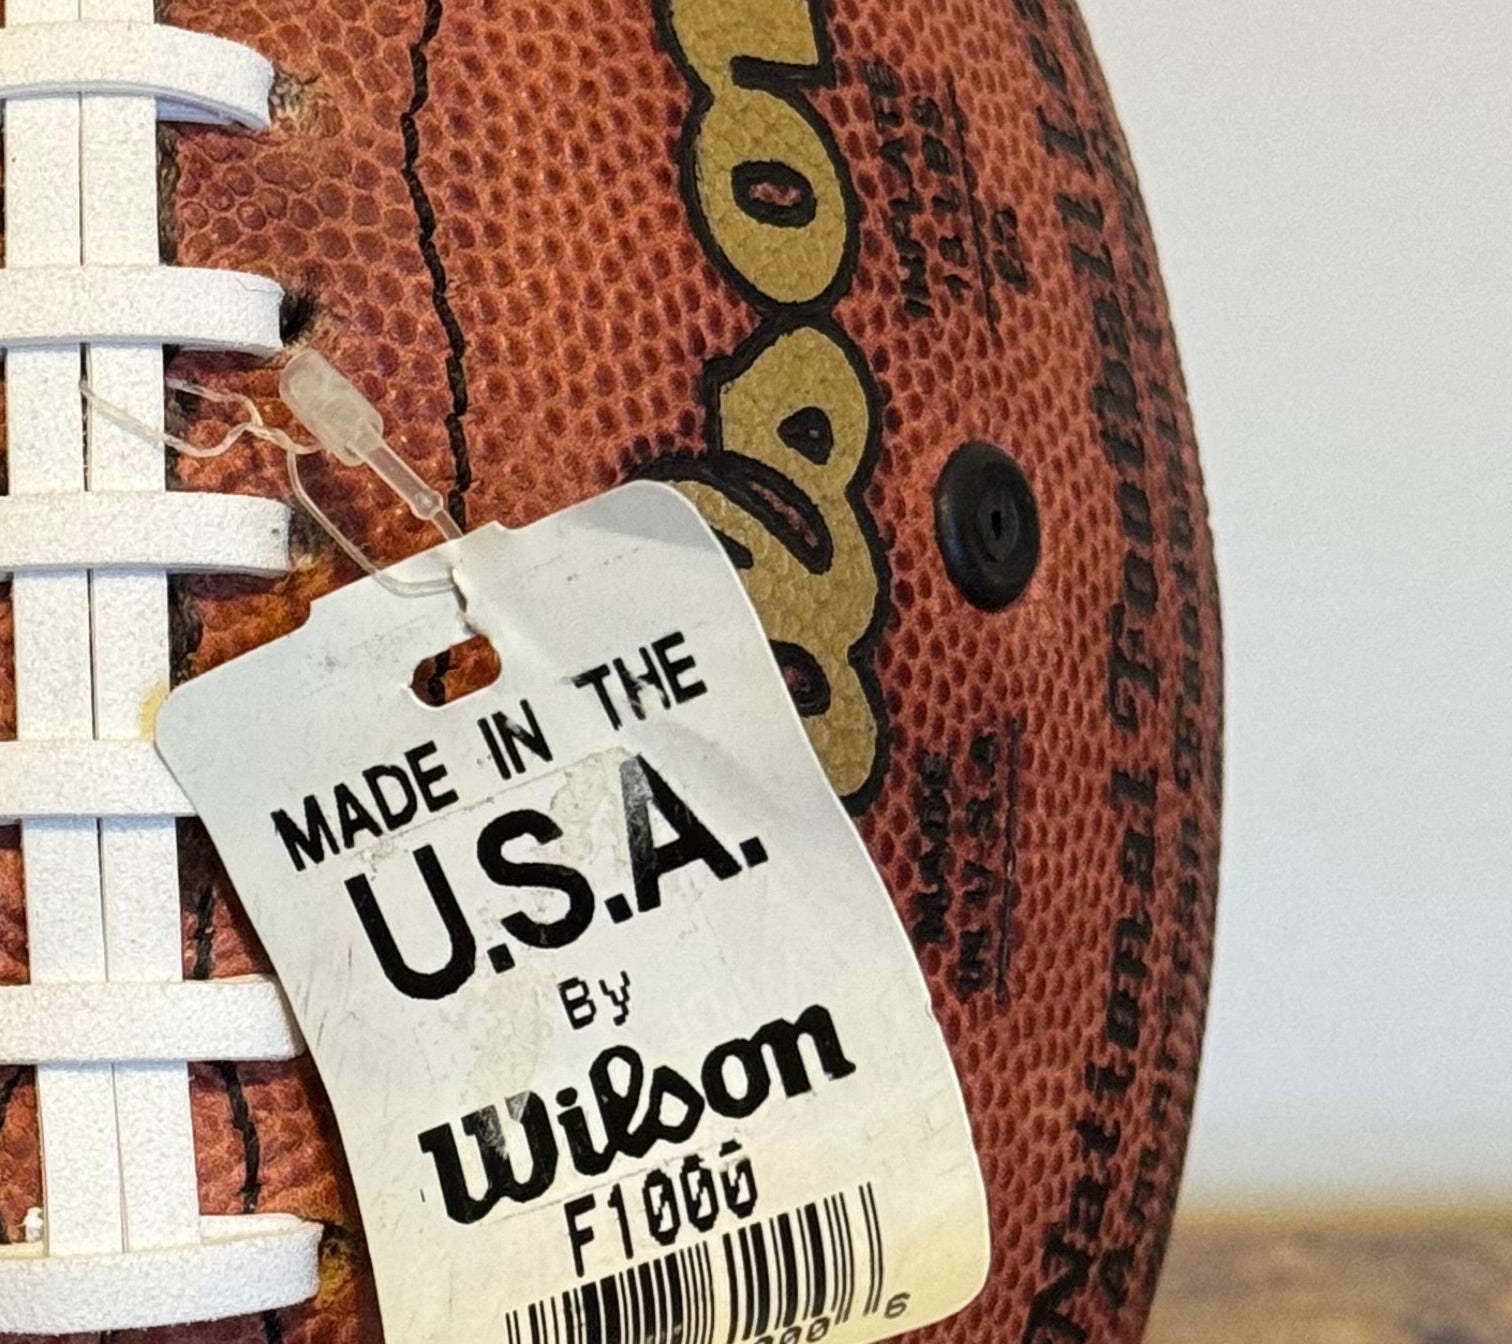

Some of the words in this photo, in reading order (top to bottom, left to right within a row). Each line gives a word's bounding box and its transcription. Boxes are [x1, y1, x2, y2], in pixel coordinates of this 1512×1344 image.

[860, 56, 943, 320] INFLATE
[1055, 188, 1163, 734] Football
[269, 739, 458, 873] MADE
[476, 699, 551, 780] IN
[571, 631, 709, 731] THE
[912, 750, 955, 944] MADE
[343, 753, 770, 1001] U.S.A.
[417, 1003, 857, 1226] Wilson
[563, 1139, 758, 1278] F1000
[882, 1291, 912, 1321] 6
